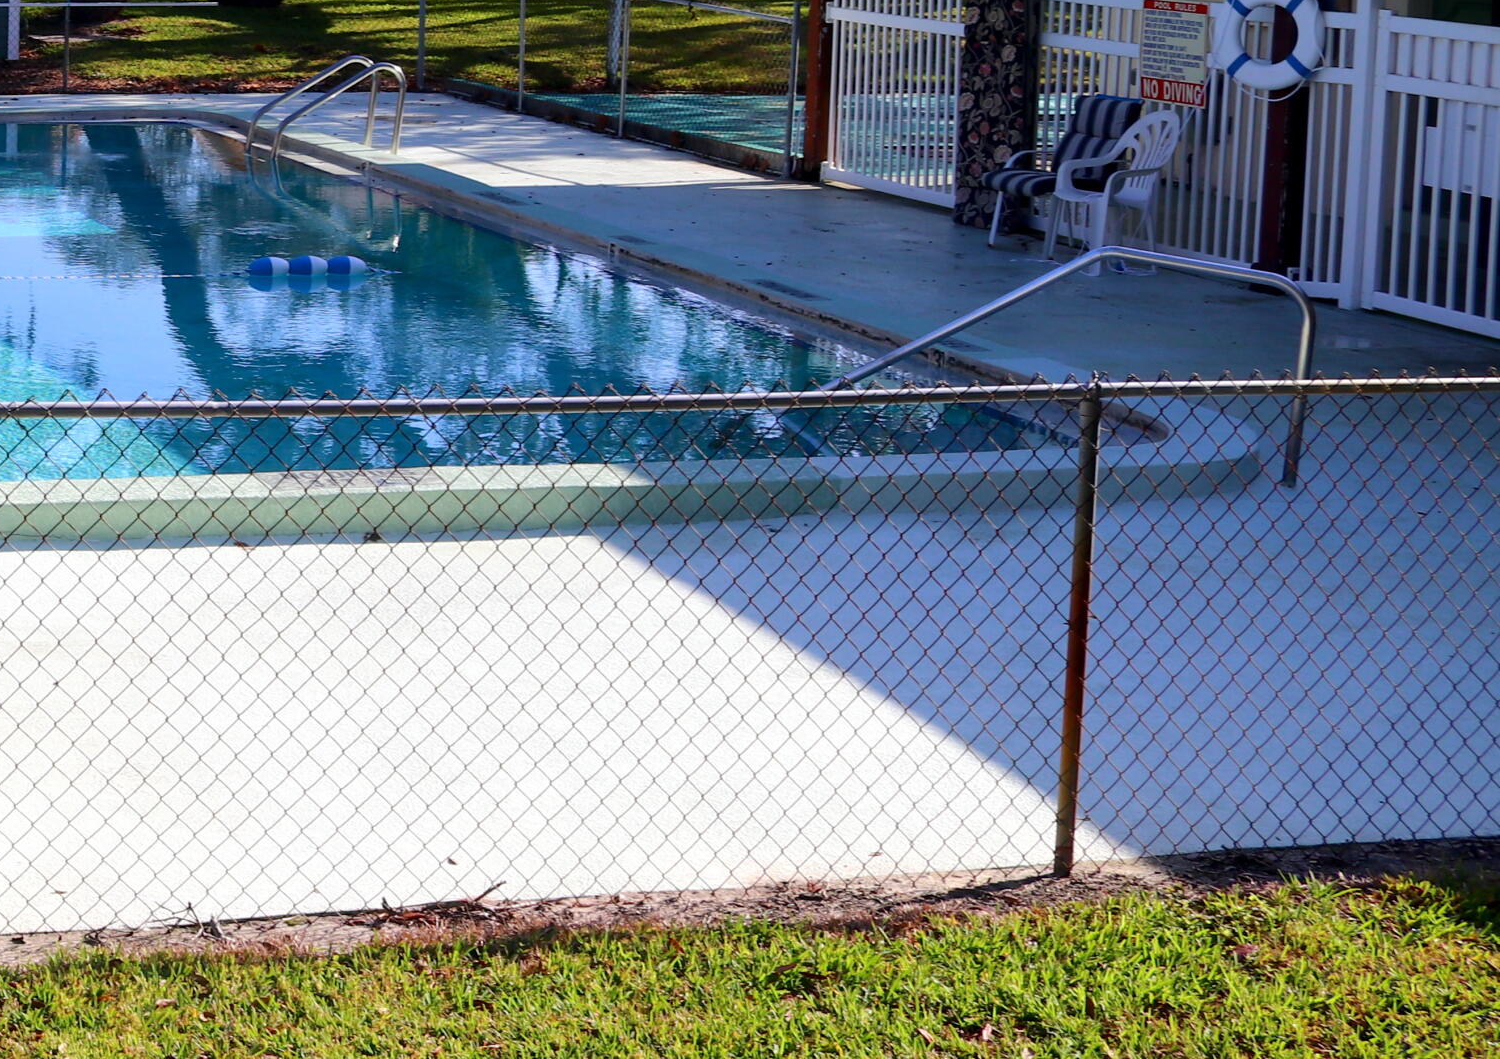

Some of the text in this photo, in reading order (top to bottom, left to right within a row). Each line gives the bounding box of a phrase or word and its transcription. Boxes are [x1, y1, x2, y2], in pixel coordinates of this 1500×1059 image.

[1153, 1, 1197, 12] POOL RULES
[1142, 78, 1203, 106] NO DIVING
